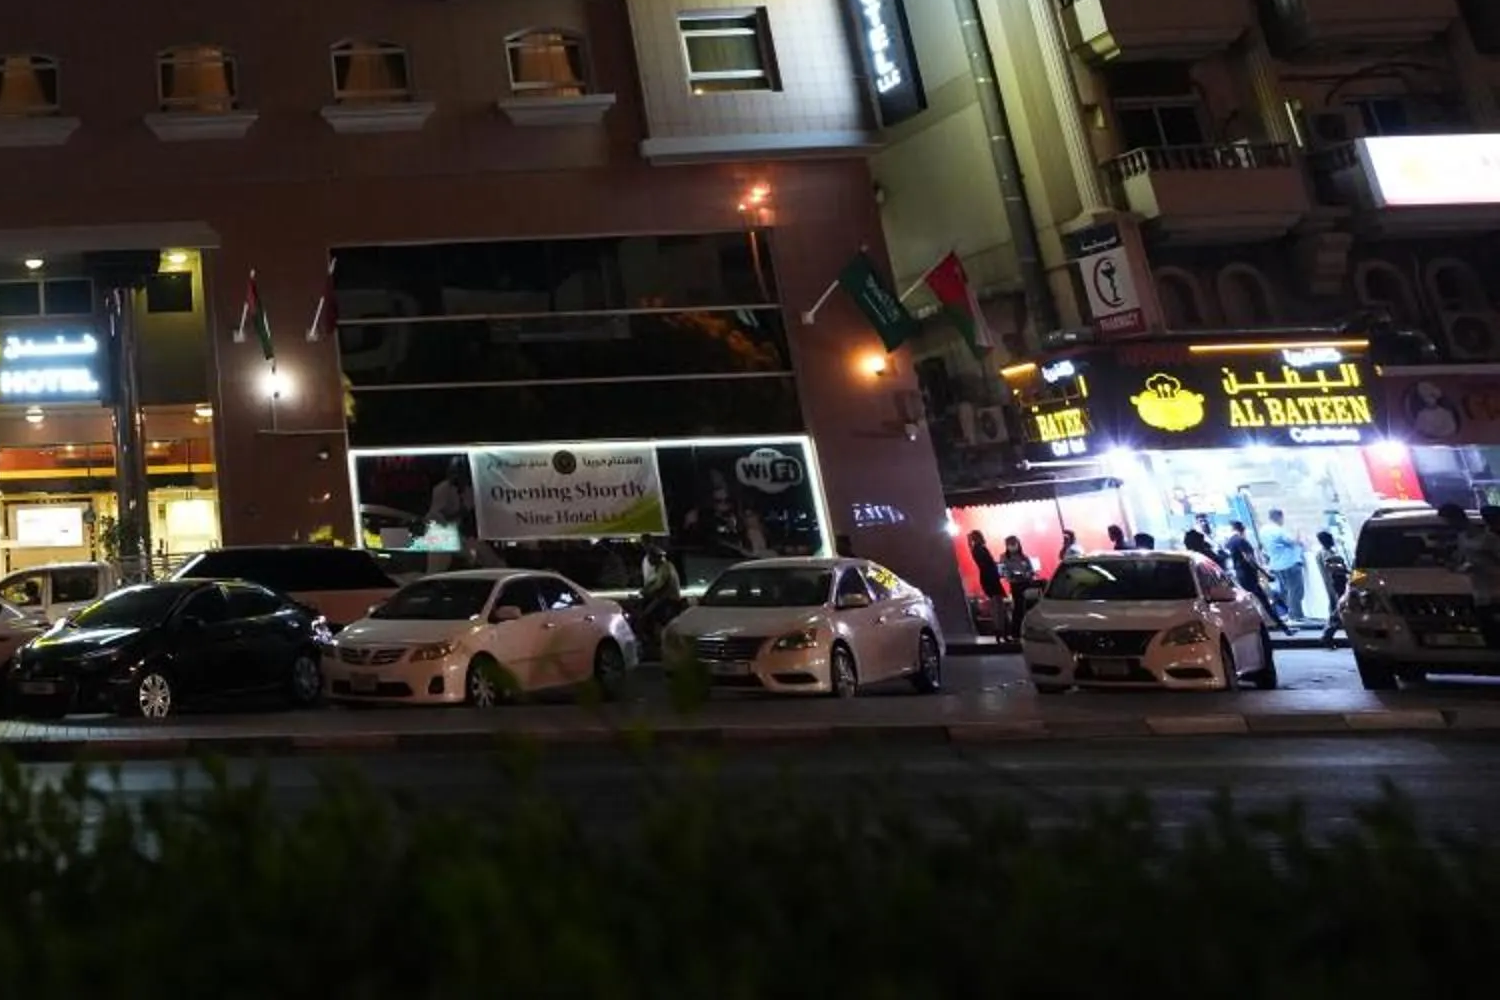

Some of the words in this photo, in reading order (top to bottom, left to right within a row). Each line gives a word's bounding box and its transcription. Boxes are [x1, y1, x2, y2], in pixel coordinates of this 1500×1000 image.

[3, 332, 99, 360] فندق
[0, 367, 99, 394] HOTEL
[1221, 362, 1361, 397] البطين
[1229, 398, 1265, 427] AL
[1265, 395, 1372, 426] BATEEN
[490, 483, 572, 504] Opening
[574, 480, 646, 499] Shortly
[515, 511, 553, 525] Nine
[555, 509, 597, 524] Hotel
